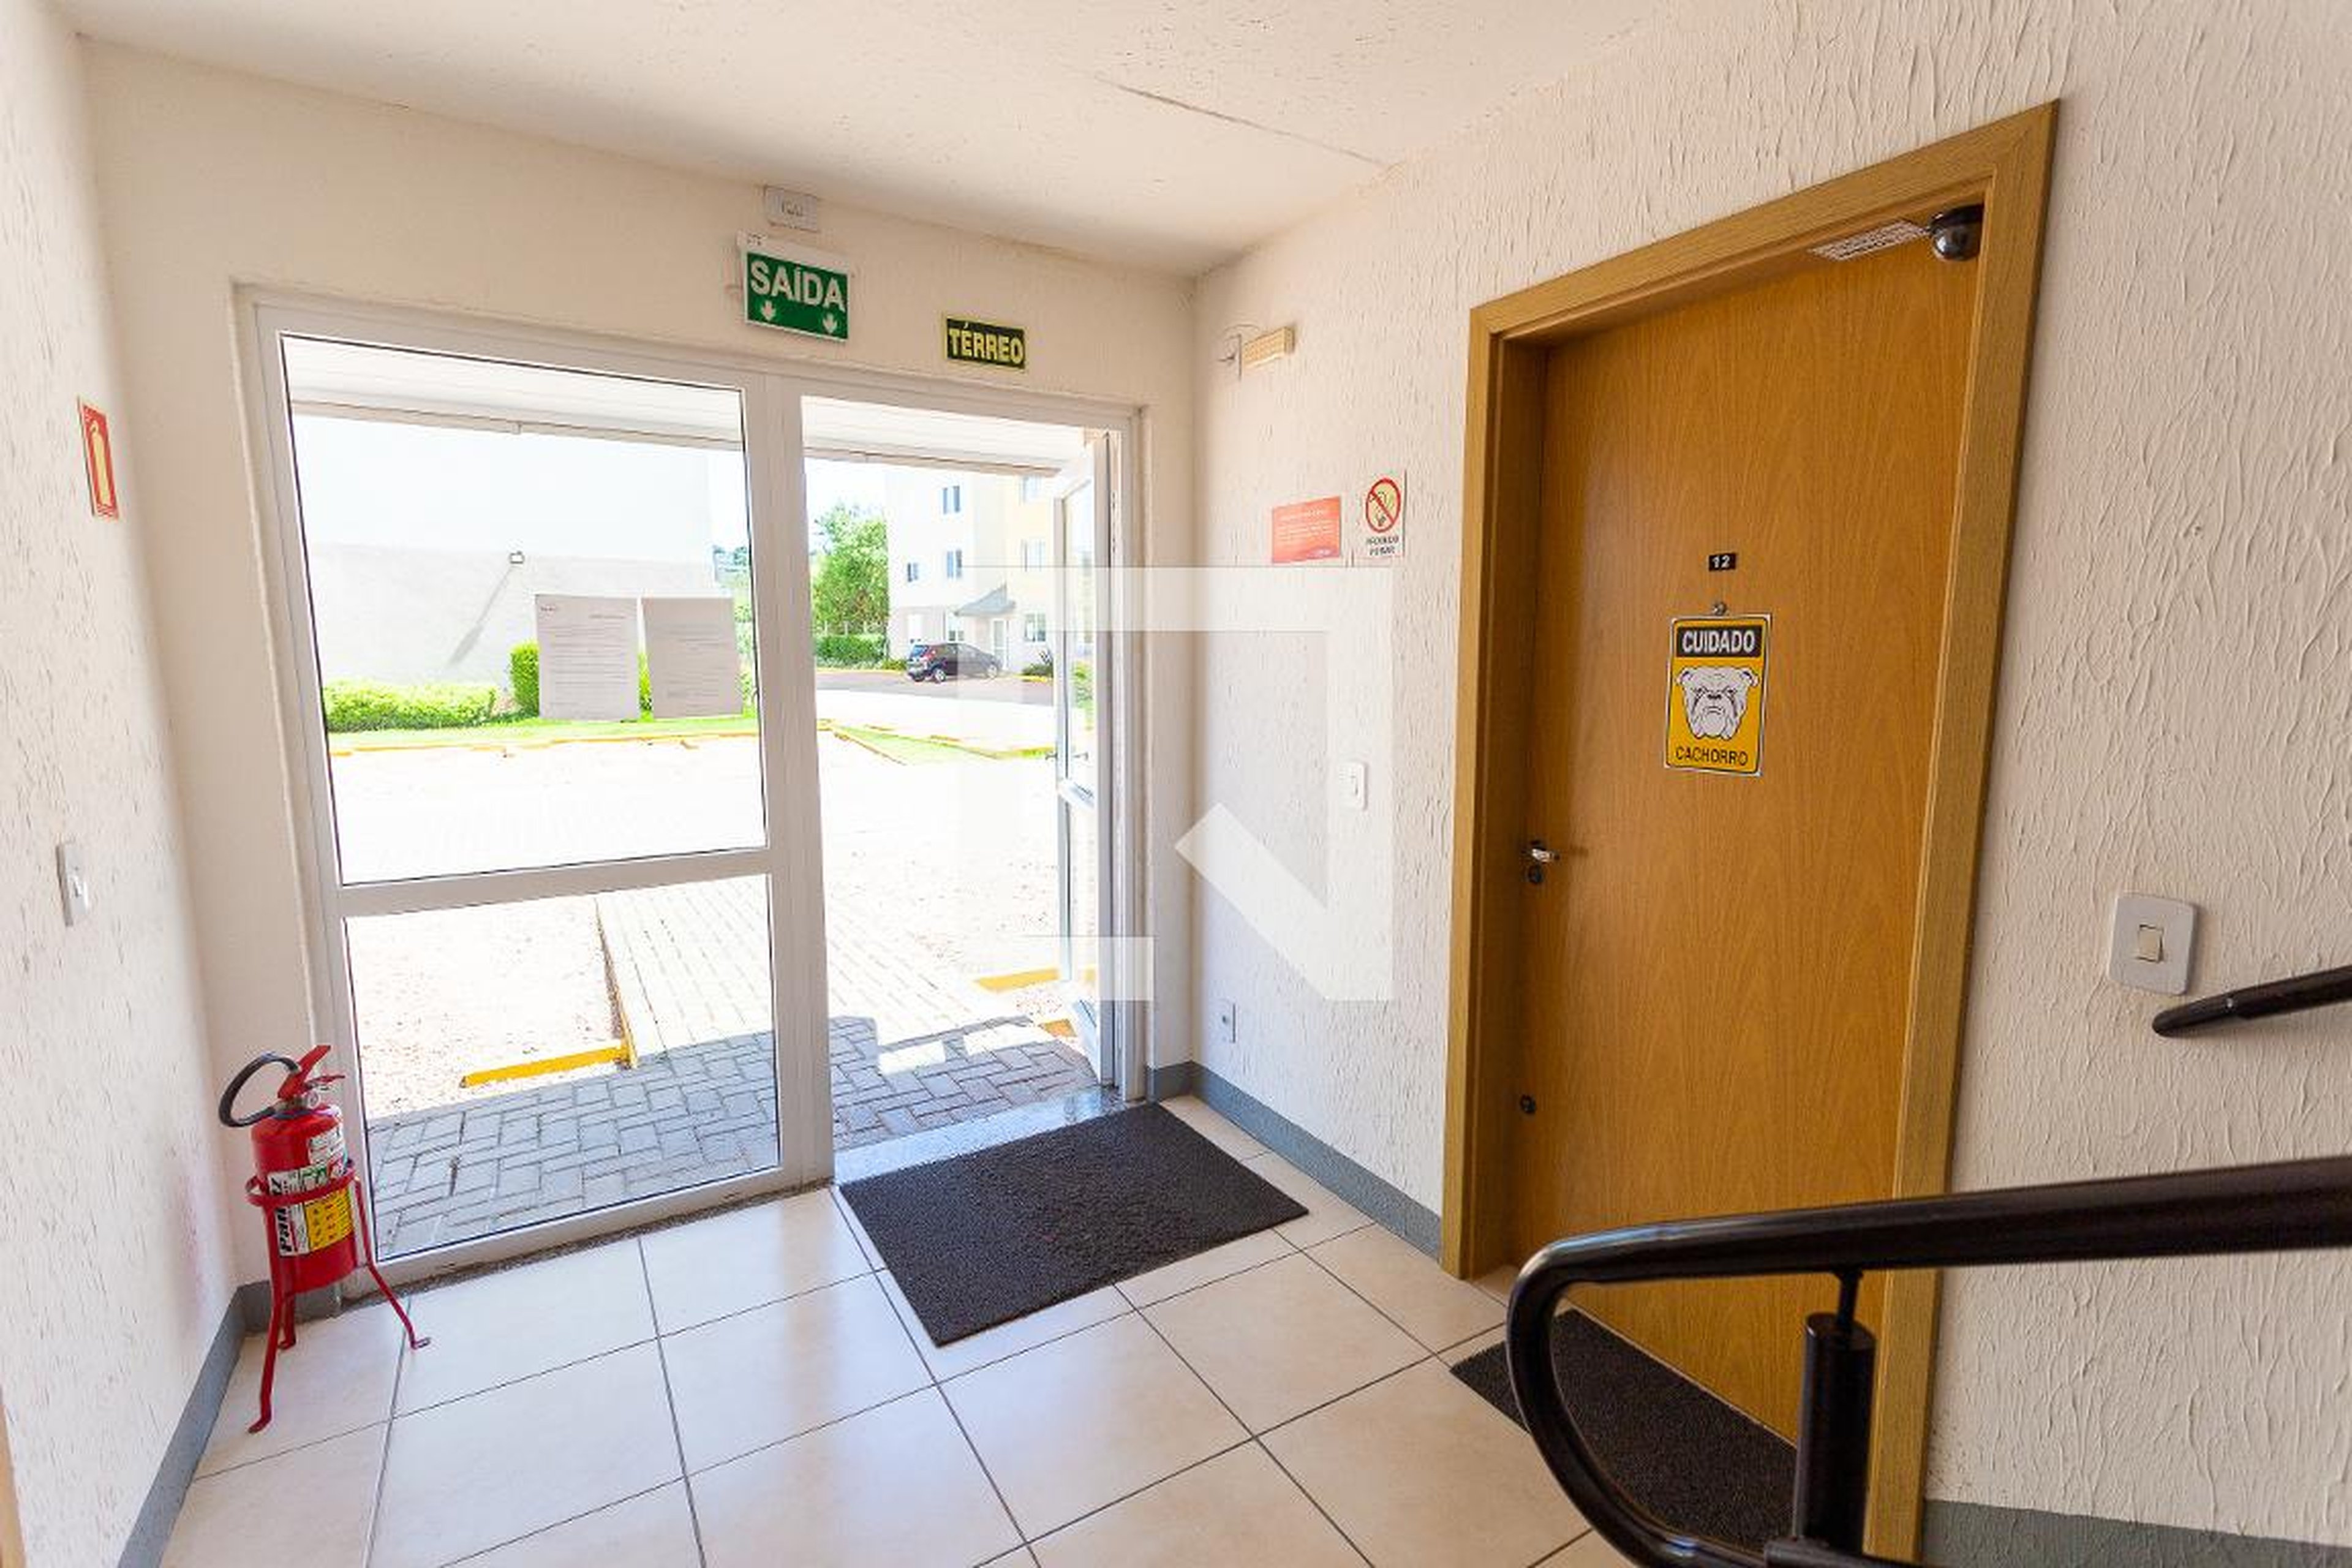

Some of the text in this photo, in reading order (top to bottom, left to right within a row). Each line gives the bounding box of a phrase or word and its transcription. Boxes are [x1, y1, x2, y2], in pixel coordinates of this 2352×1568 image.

[750, 260, 846, 313] SAÍDA
[949, 322, 1024, 365] TÉRREO
[1712, 554, 1730, 568] 12
[1682, 630, 1755, 654] CUIDADO
[1676, 746, 1748, 766] CACHORRO
